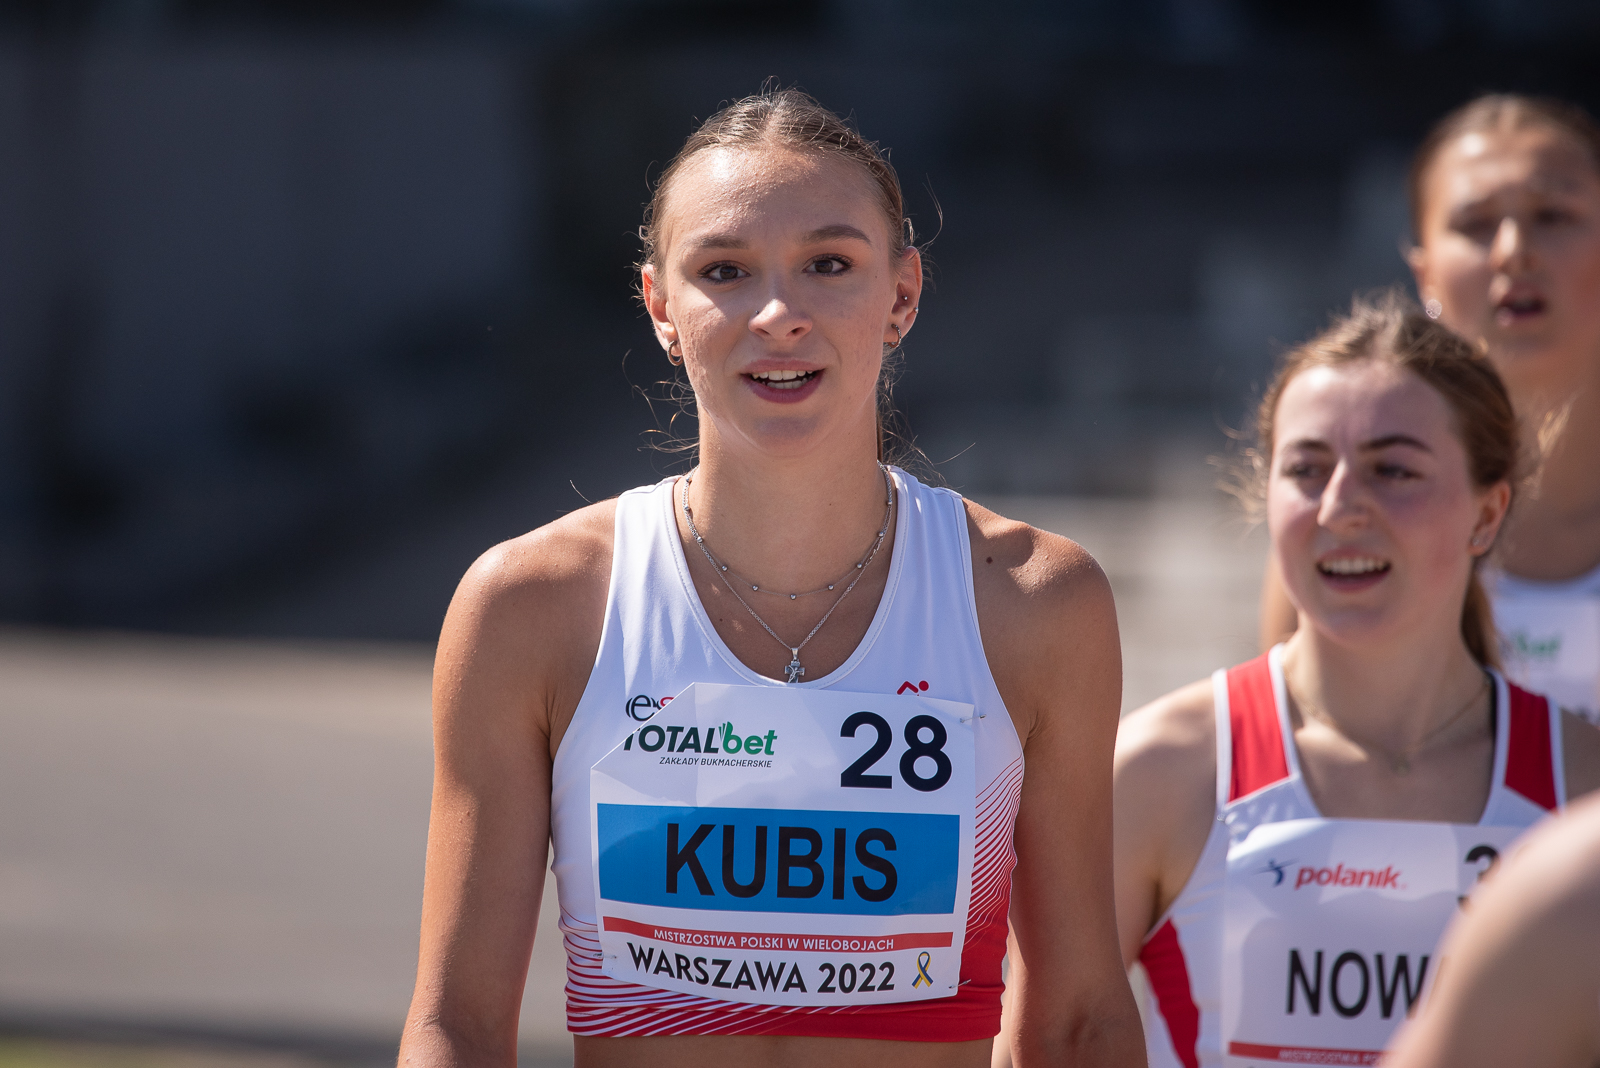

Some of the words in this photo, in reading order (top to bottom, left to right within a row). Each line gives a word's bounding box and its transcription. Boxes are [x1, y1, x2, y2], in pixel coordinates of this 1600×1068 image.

[659, 756, 699, 766] ZAKŁADY
[700, 757, 773, 769] BUKMACHERSKIE
[840, 711, 952, 792] 28
[666, 823, 898, 902] KUBIS
[627, 942, 808, 994] WARSZAWA
[817, 961, 895, 993] 2022
[653, 929, 737, 947] MISTRZOSTWA
[740, 936, 783, 949] POLSKI
[787, 938, 799, 949] W
[803, 938, 894, 951] WIELOBOJACH
[1286, 948, 1436, 1020] NOW
